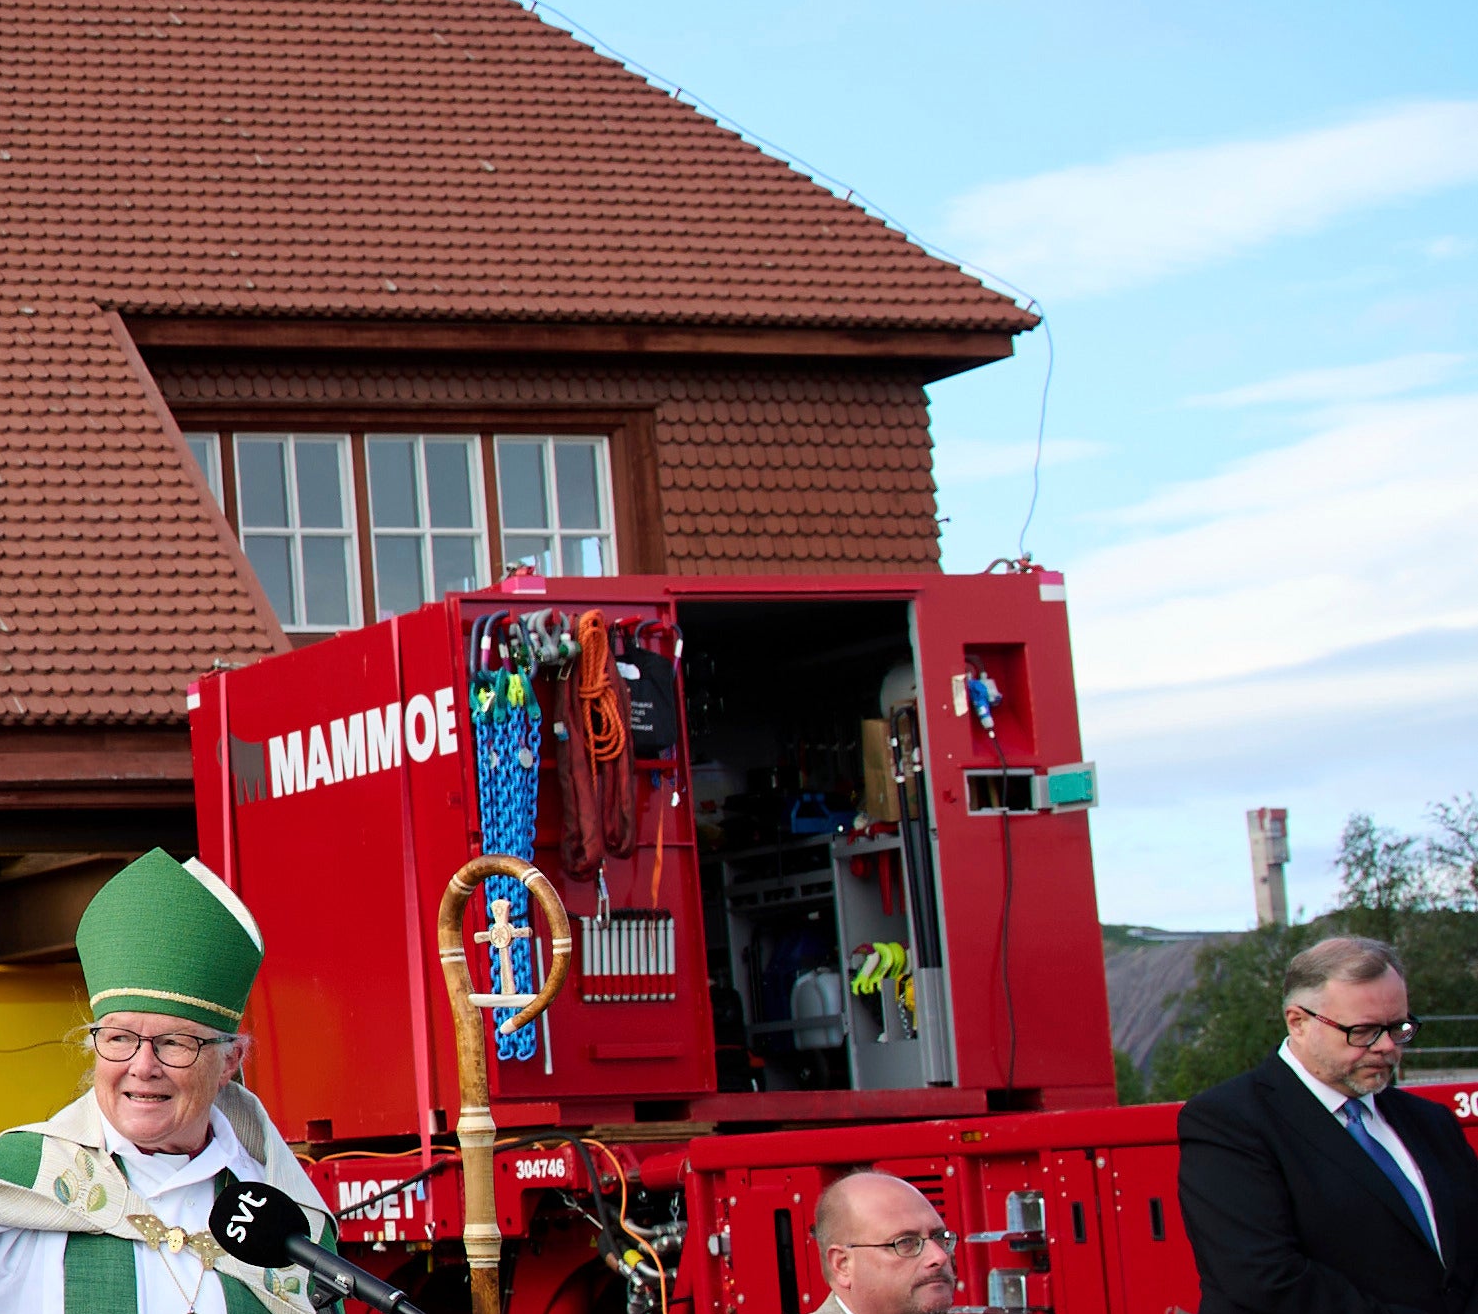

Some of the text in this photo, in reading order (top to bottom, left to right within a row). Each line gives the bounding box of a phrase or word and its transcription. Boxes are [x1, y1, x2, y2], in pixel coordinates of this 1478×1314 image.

[268, 686, 459, 799] MAMMOE
[515, 1158, 565, 1180] 304746
[226, 1190, 268, 1243] svt
[338, 1179, 418, 1221] MOET
